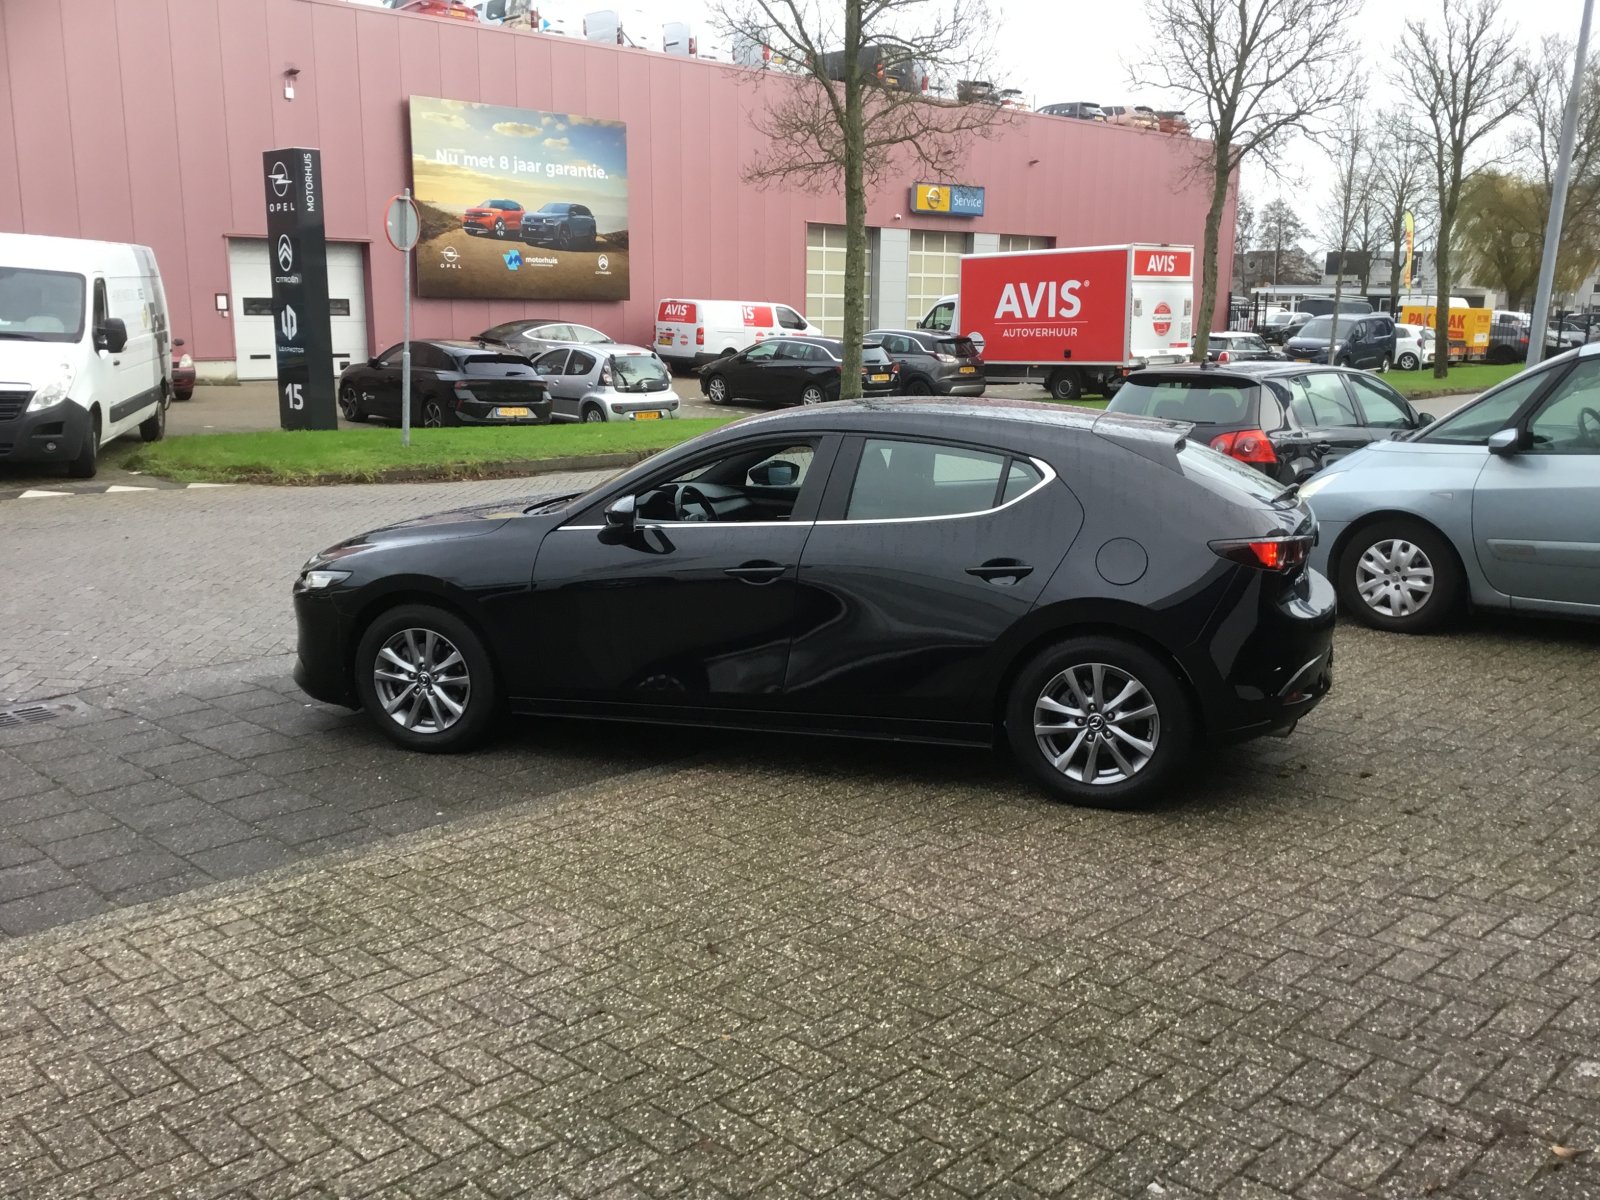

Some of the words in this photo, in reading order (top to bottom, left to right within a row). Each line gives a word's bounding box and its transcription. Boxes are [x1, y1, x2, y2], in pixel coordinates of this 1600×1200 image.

[436, 149, 458, 165] Nu
[463, 153, 495, 168] met
[499, 155, 509, 170] 8
[512, 156, 541, 174] jaar
[545, 163, 609, 180] garantie.
[303, 153, 315, 212] MOTORHUIS
[269, 202, 295, 212] OPEL
[954, 194, 982, 208] Service
[525, 256, 558, 264] motorhuis
[1407, 312, 1432, 327] PAK
[1002, 327, 1078, 338] AUTOVERHUUR
[285, 382, 304, 410] 15
